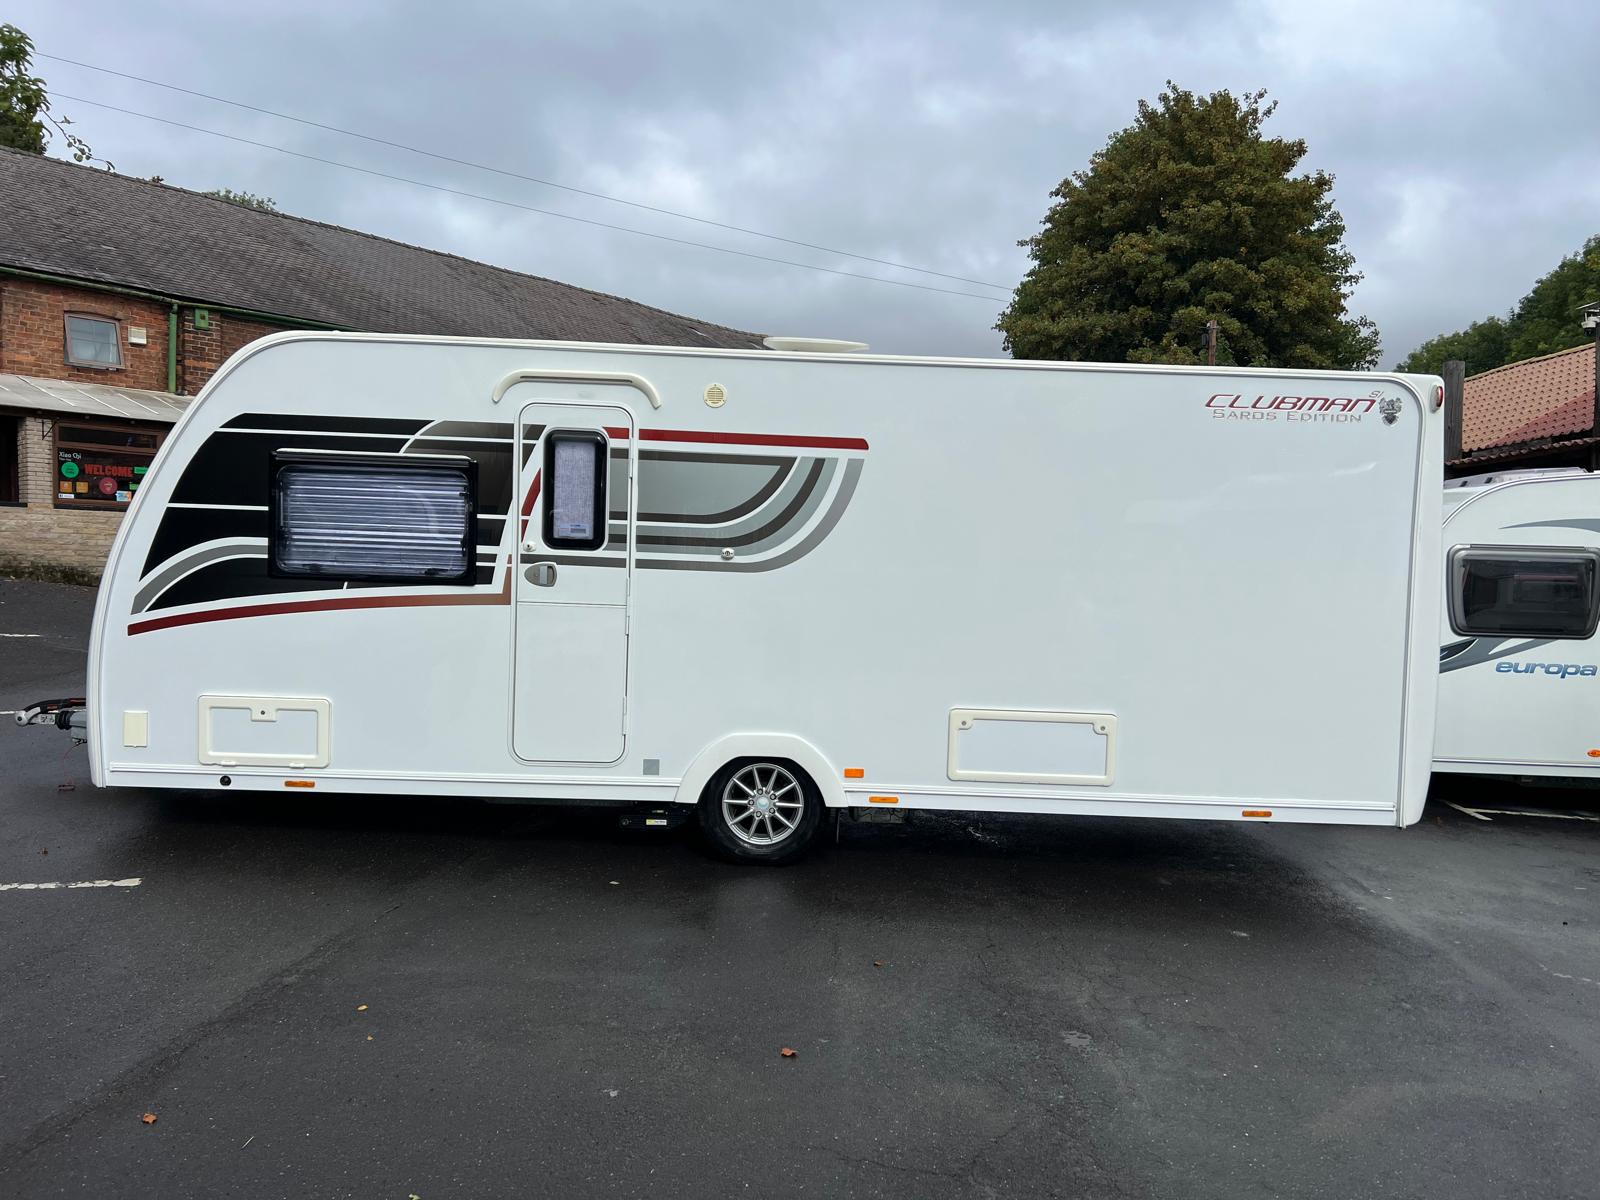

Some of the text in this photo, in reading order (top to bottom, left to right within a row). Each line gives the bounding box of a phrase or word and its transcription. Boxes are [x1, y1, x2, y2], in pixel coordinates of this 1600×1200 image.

[1286, 411, 1362, 423] EDITION
[84, 463, 132, 477] WELCOME
[1495, 661, 1598, 679] europa
